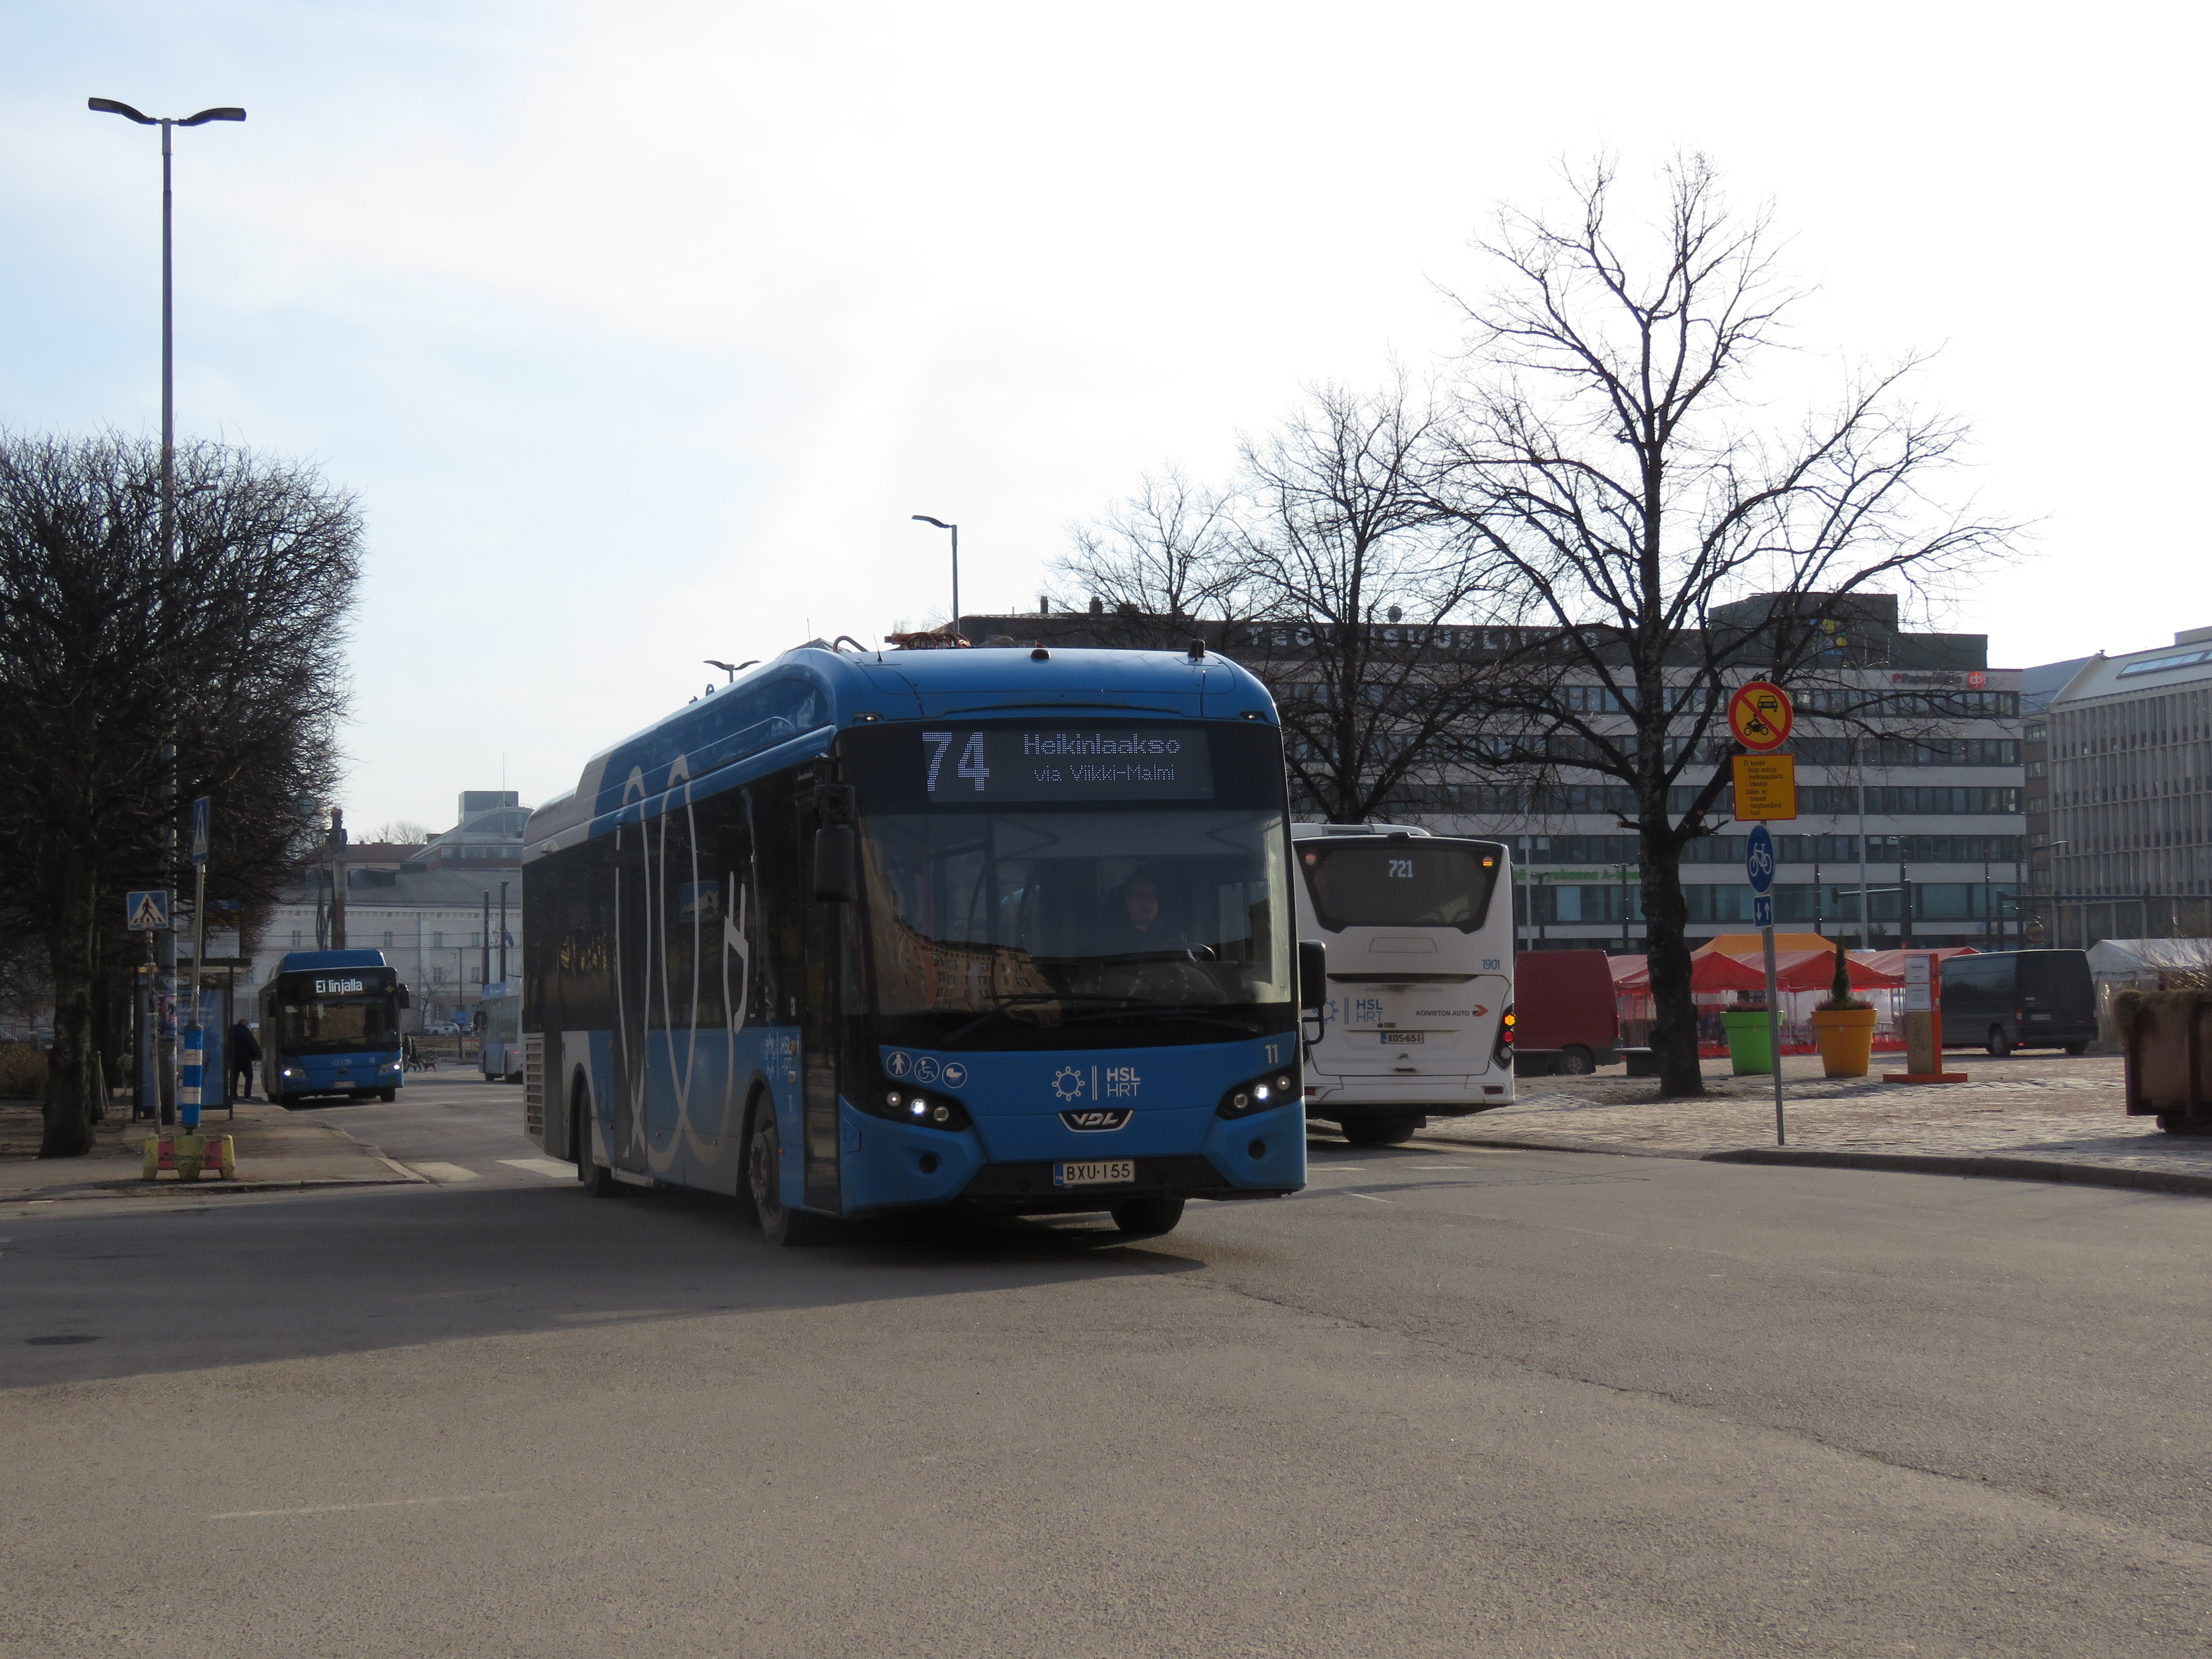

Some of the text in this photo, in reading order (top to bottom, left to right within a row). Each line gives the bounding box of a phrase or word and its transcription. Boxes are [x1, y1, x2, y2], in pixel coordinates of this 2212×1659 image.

[922, 732, 1181, 792] 74 Heikinlaakso
[1034, 764, 1175, 781] via Viikki-Malmi
[1388, 859, 1414, 878] 721
[1482, 959, 1500, 970] 1901
[315, 978, 363, 995] Ei linjalla
[1356, 999, 1383, 1011] HSL
[1357, 1011, 1383, 1022] HRT
[1265, 1044, 1279, 1064] 11
[1106, 1067, 1141, 1082] HSL
[1107, 1082, 1141, 1097] HRT
[1070, 1112, 1119, 1126] VDL
[1067, 1164, 1130, 1181] BXU-155
